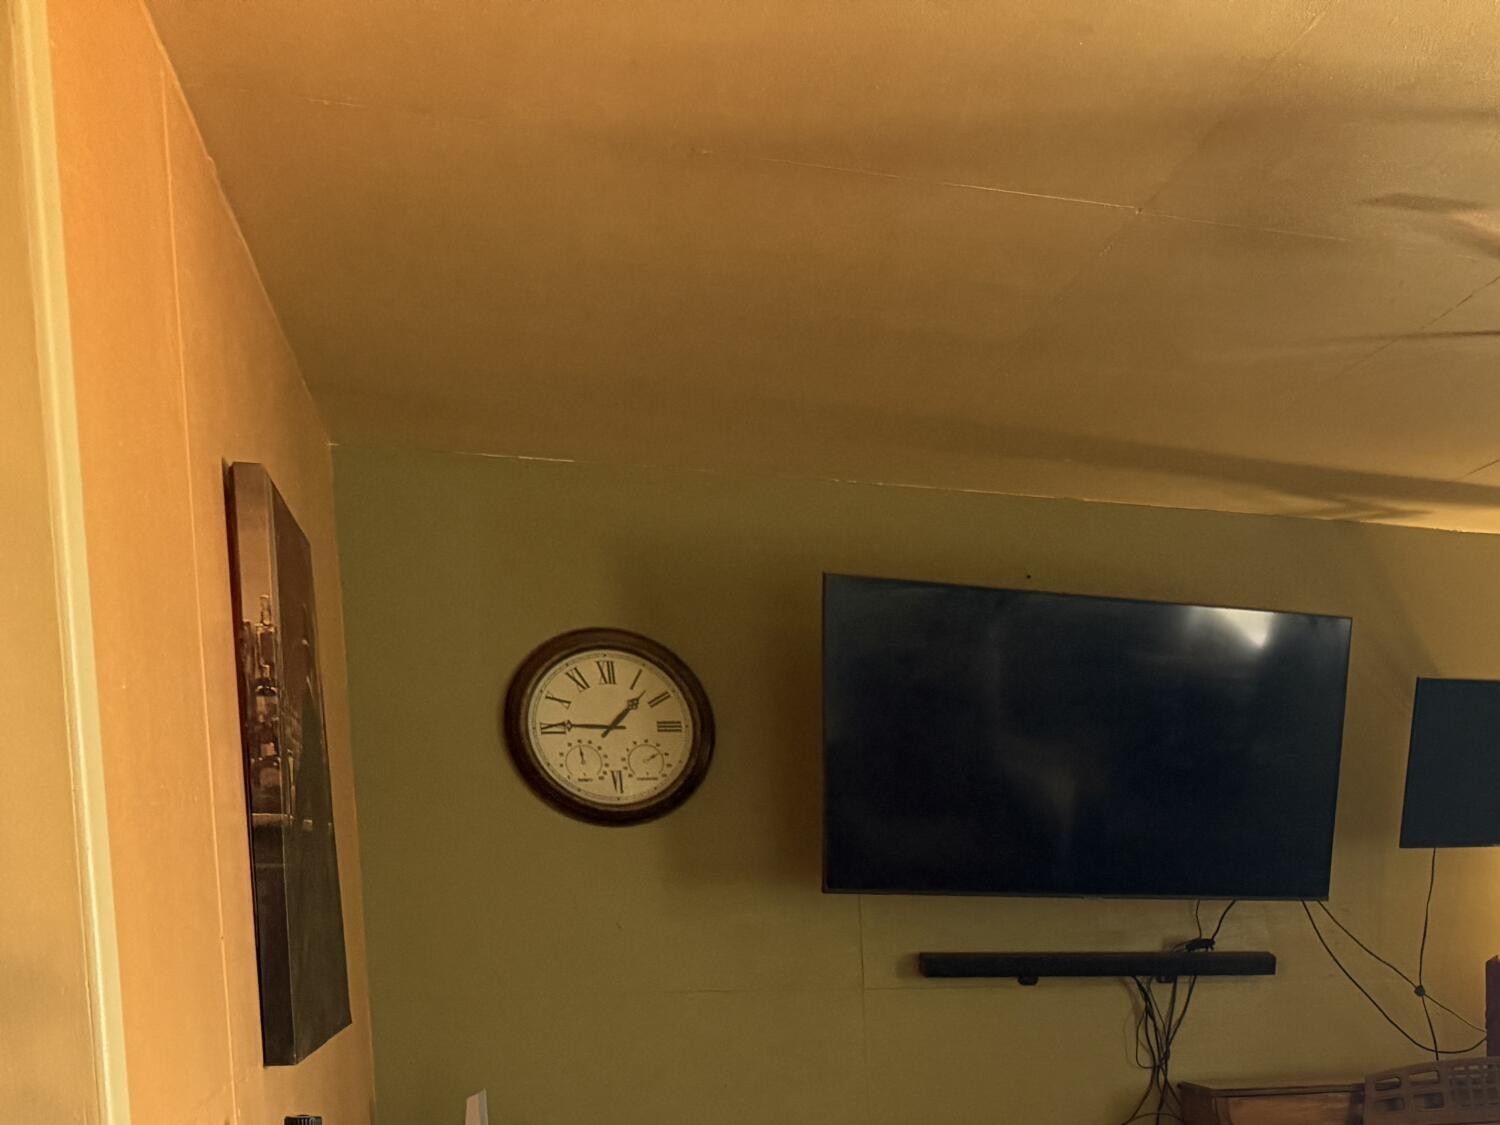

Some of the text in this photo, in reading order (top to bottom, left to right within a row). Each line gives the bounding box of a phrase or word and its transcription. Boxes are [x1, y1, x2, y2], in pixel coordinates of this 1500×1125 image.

[566, 666, 591, 693] XI
[596, 660, 616, 685] XII
[545, 691, 571, 710] X
[648, 691, 671, 708] II
[656, 720, 682, 733] III
[611, 770, 625, 794] VI
